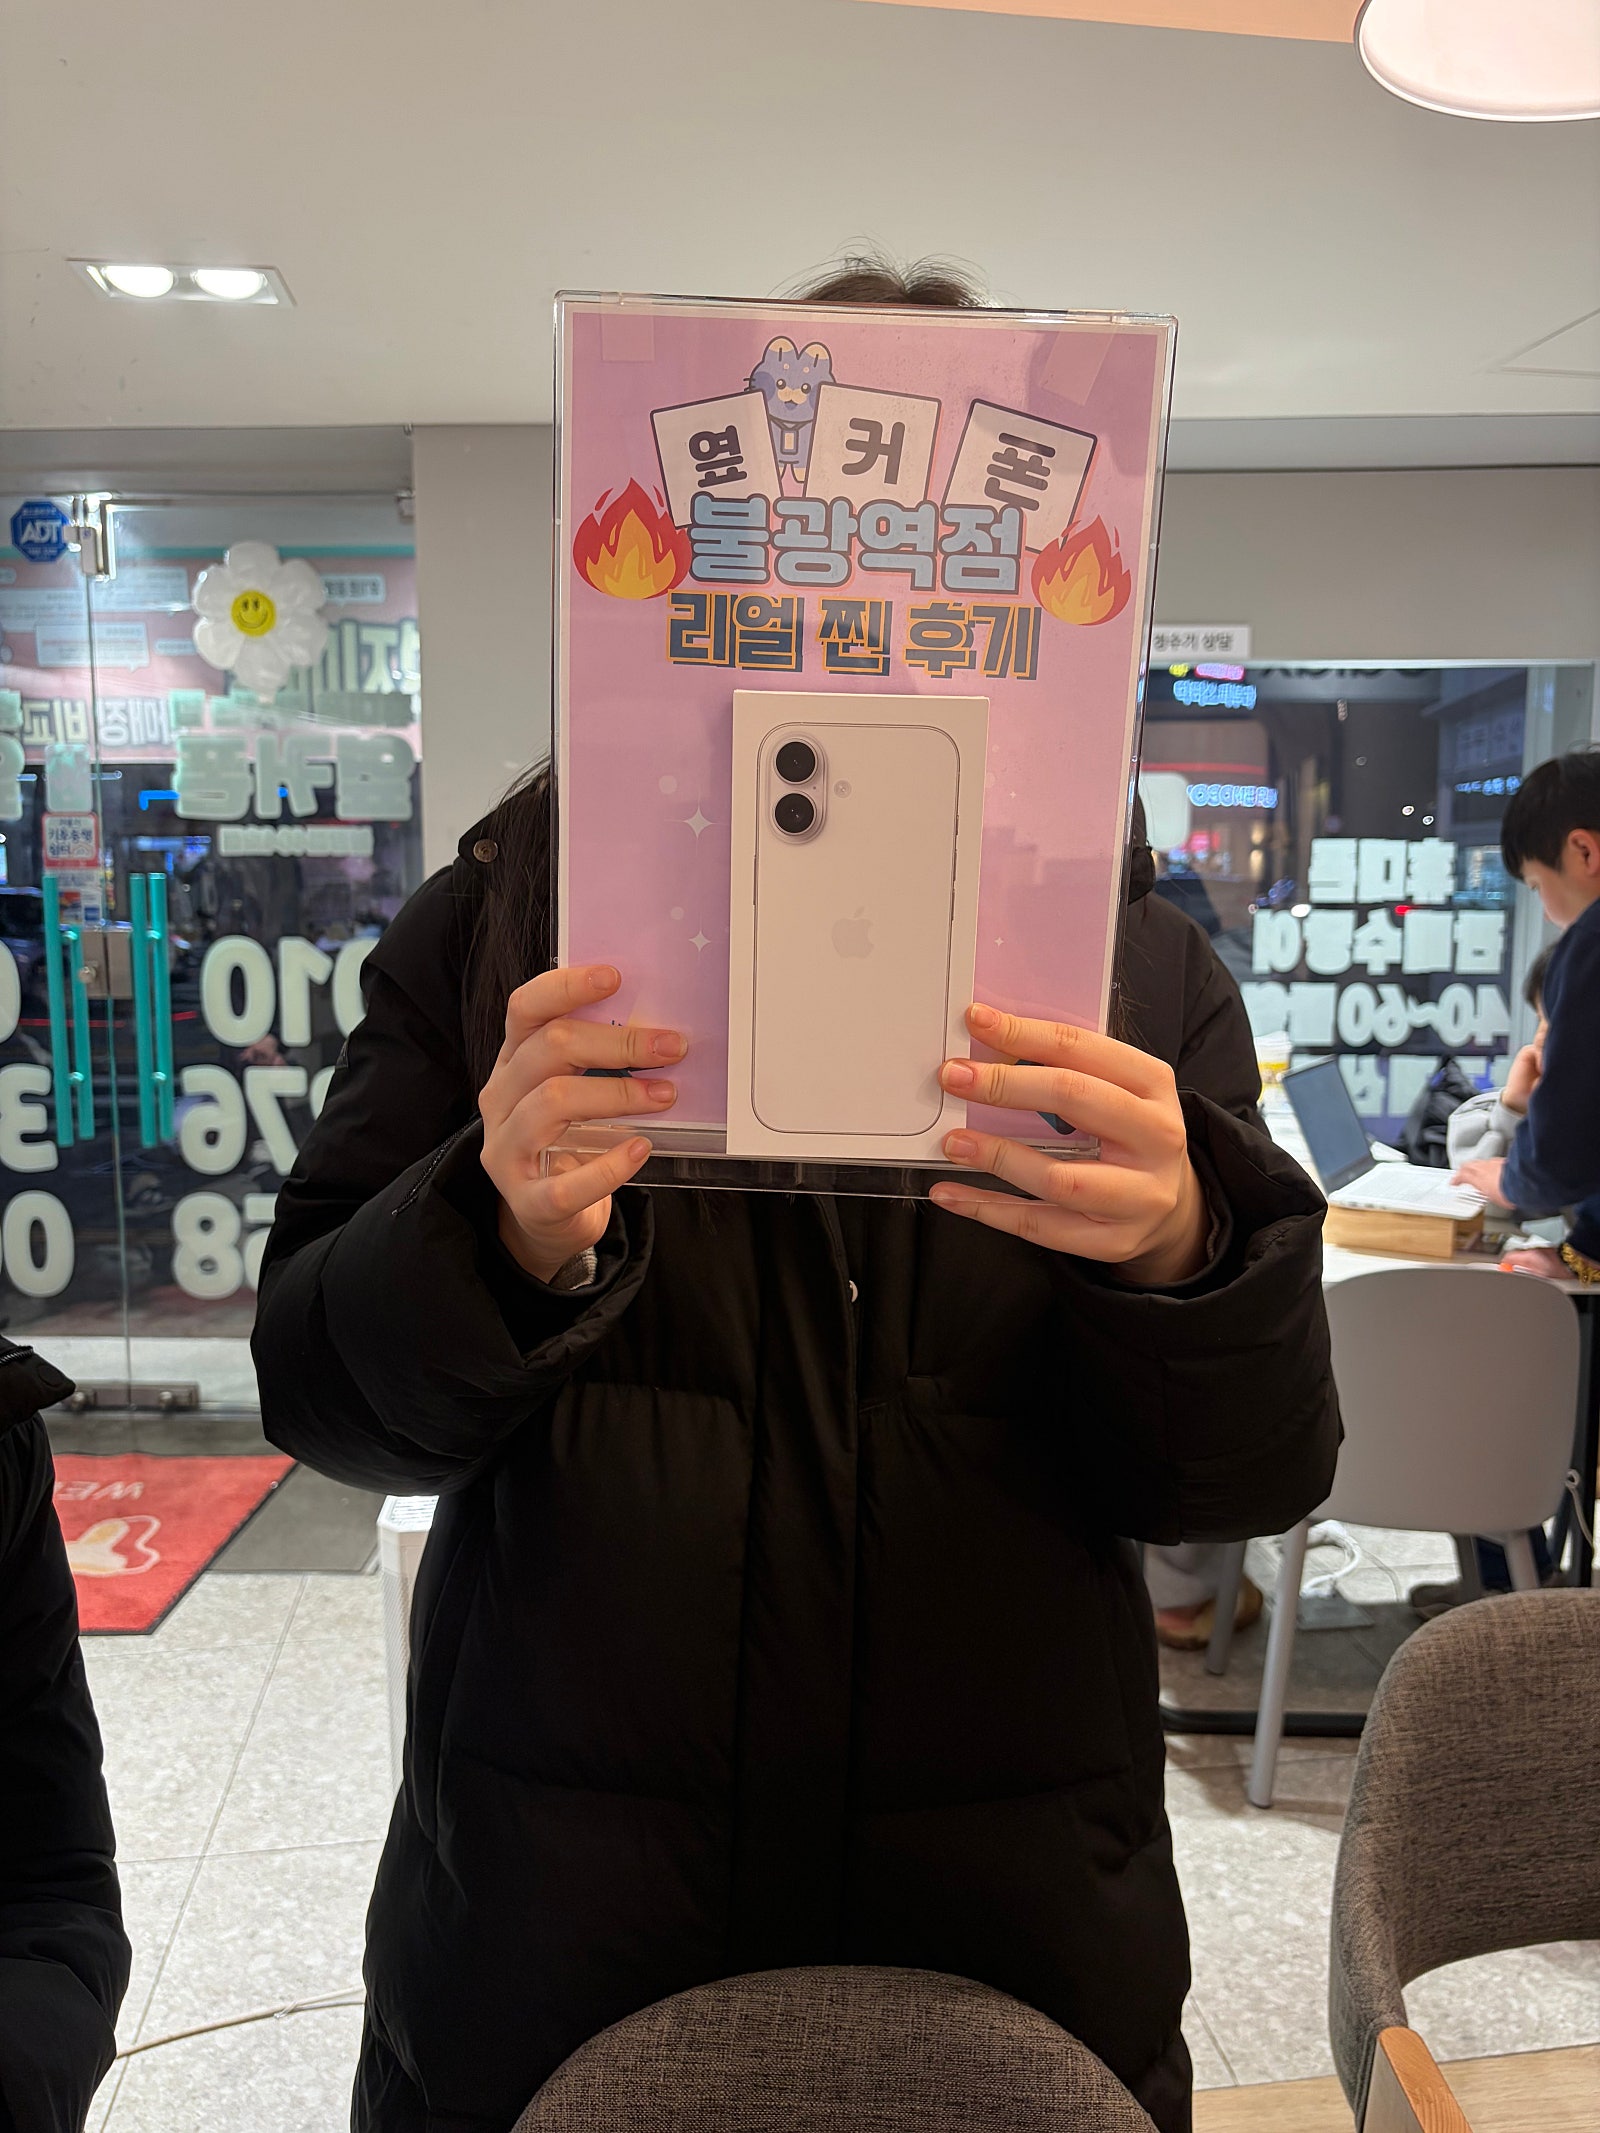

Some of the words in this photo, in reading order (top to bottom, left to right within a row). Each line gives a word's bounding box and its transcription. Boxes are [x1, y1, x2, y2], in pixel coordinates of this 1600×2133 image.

[842, 417, 906, 485] 커
[984, 432, 1056, 511] 폰
[20, 519, 62, 544] ADT
[690, 491, 1024, 595] 불광역점
[667, 589, 805, 673] 리얼
[817, 596, 893, 677] 찐
[904, 600, 1042, 681] 후기
